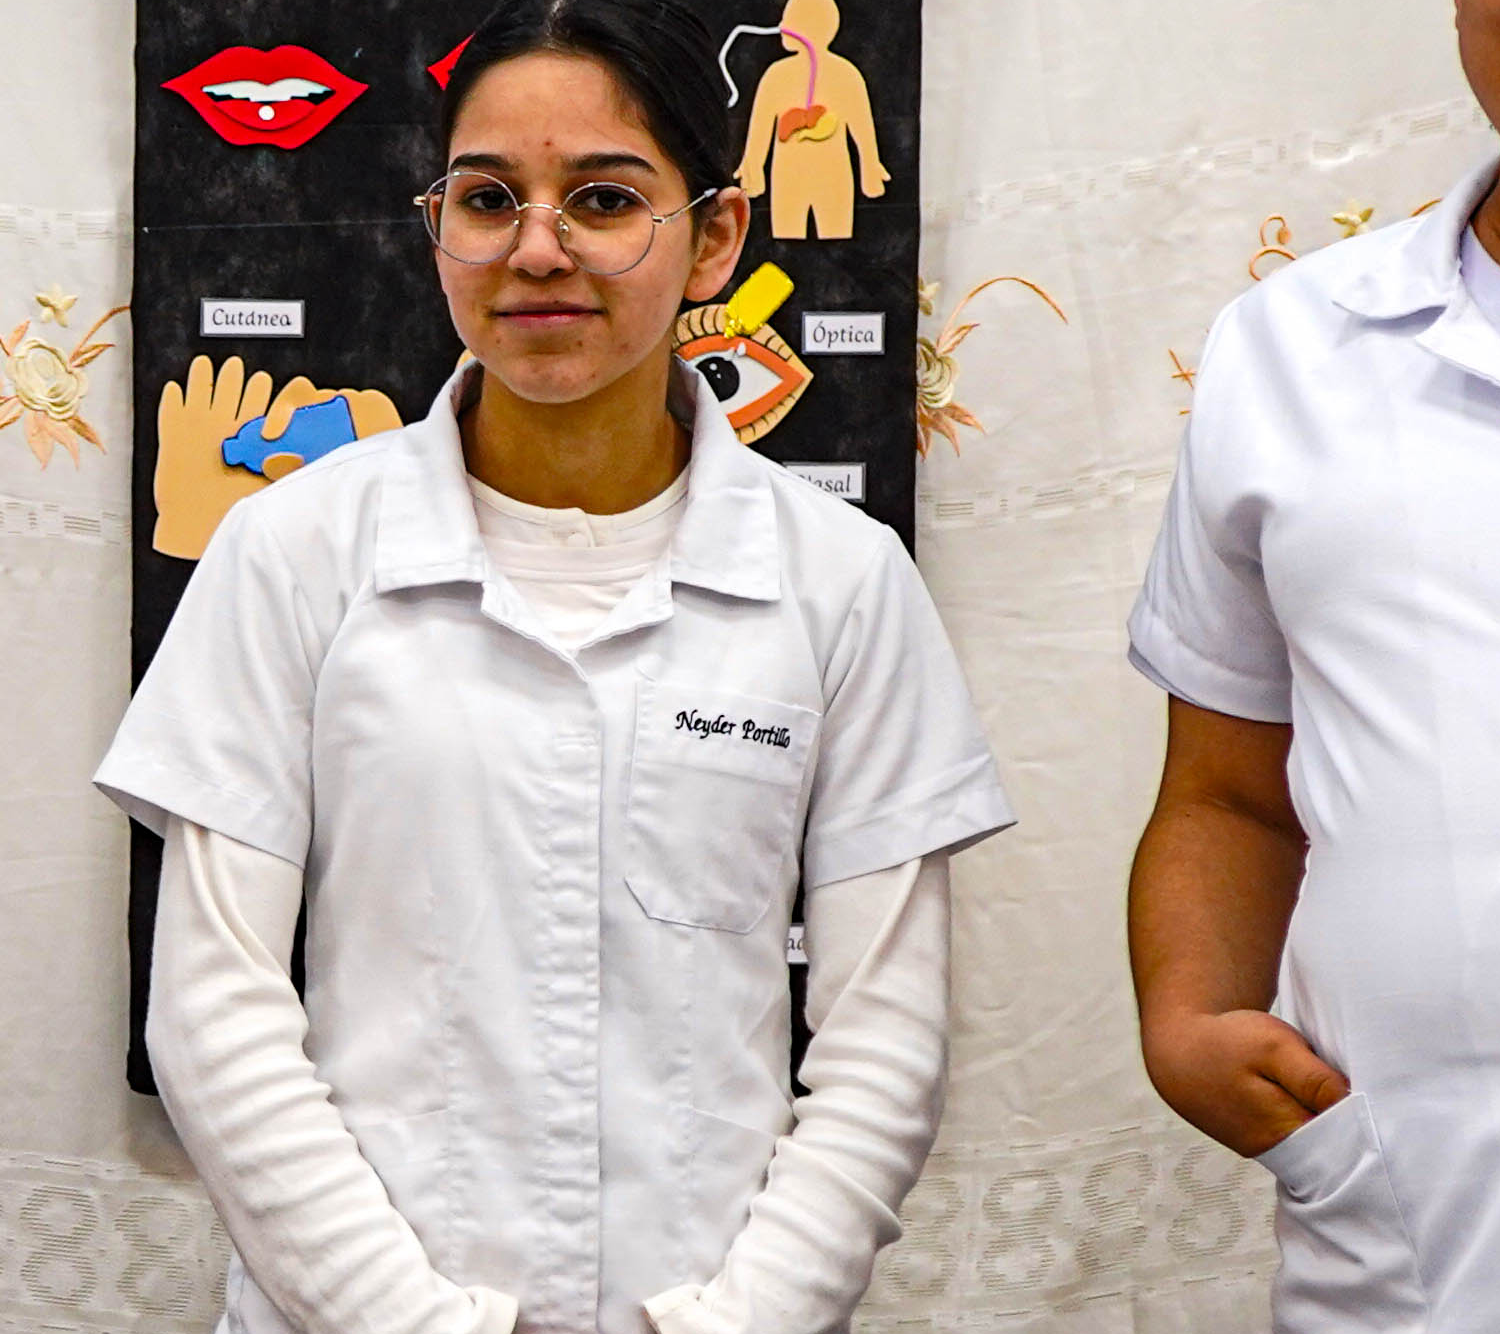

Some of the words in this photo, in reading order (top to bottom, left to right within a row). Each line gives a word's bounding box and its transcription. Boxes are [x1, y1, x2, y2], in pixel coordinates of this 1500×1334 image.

[212, 308, 292, 327] Cutánea
[813, 320, 875, 348] Óptica
[675, 709, 736, 740] Neyder
[742, 718, 791, 749] Portillo
